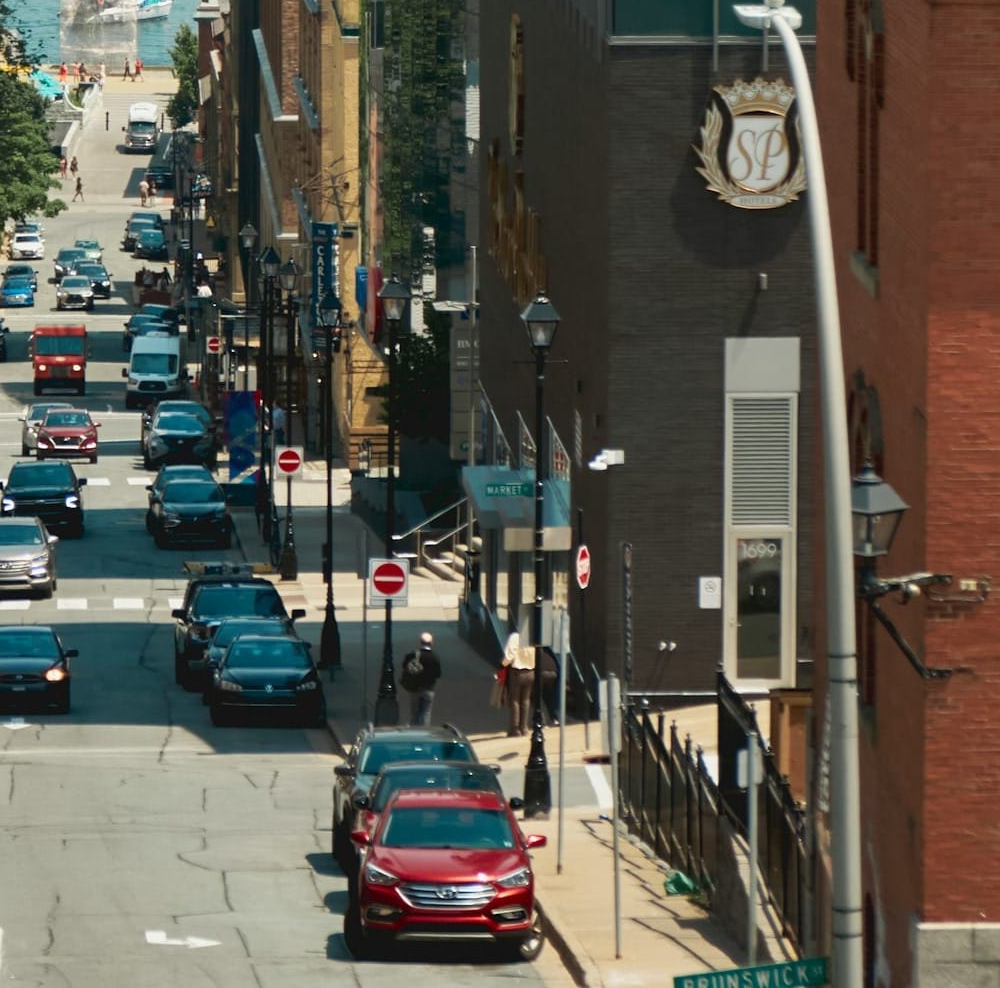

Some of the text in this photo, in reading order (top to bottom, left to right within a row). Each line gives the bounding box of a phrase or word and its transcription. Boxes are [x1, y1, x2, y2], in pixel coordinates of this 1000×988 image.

[315, 245, 325, 327] CARLEN
[487, 486, 521, 495] MARKET
[742, 543, 777, 558] 1699
